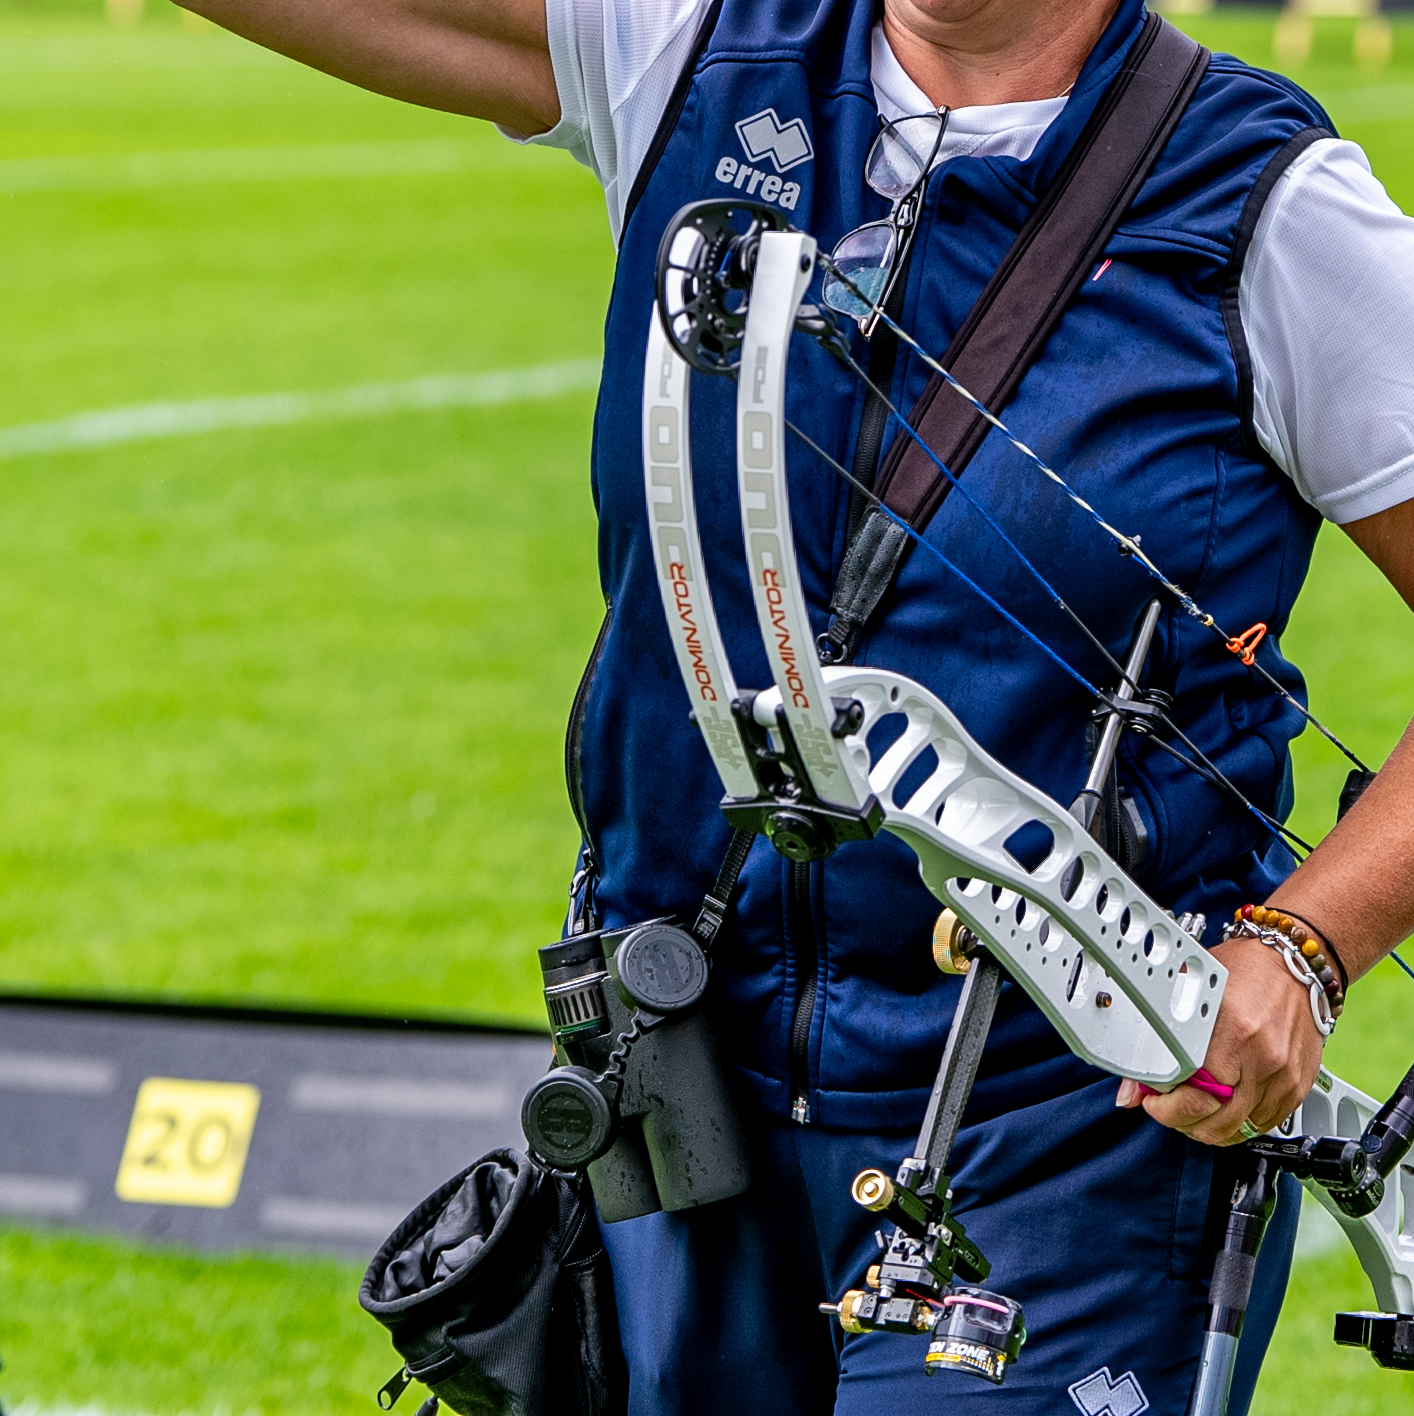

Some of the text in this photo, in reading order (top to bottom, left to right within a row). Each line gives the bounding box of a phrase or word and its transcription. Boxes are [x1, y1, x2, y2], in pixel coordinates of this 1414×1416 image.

[649, 405, 693, 582] DUO
[743, 410, 787, 588] DUO
[669, 561, 718, 703] DOMINATOR
[762, 568, 810, 710] DOMINATOR
[702, 706, 745, 771] PSE
[794, 713, 839, 779] PSE
[136, 1107, 234, 1177] 20
[947, 1343, 990, 1361] ZONE
